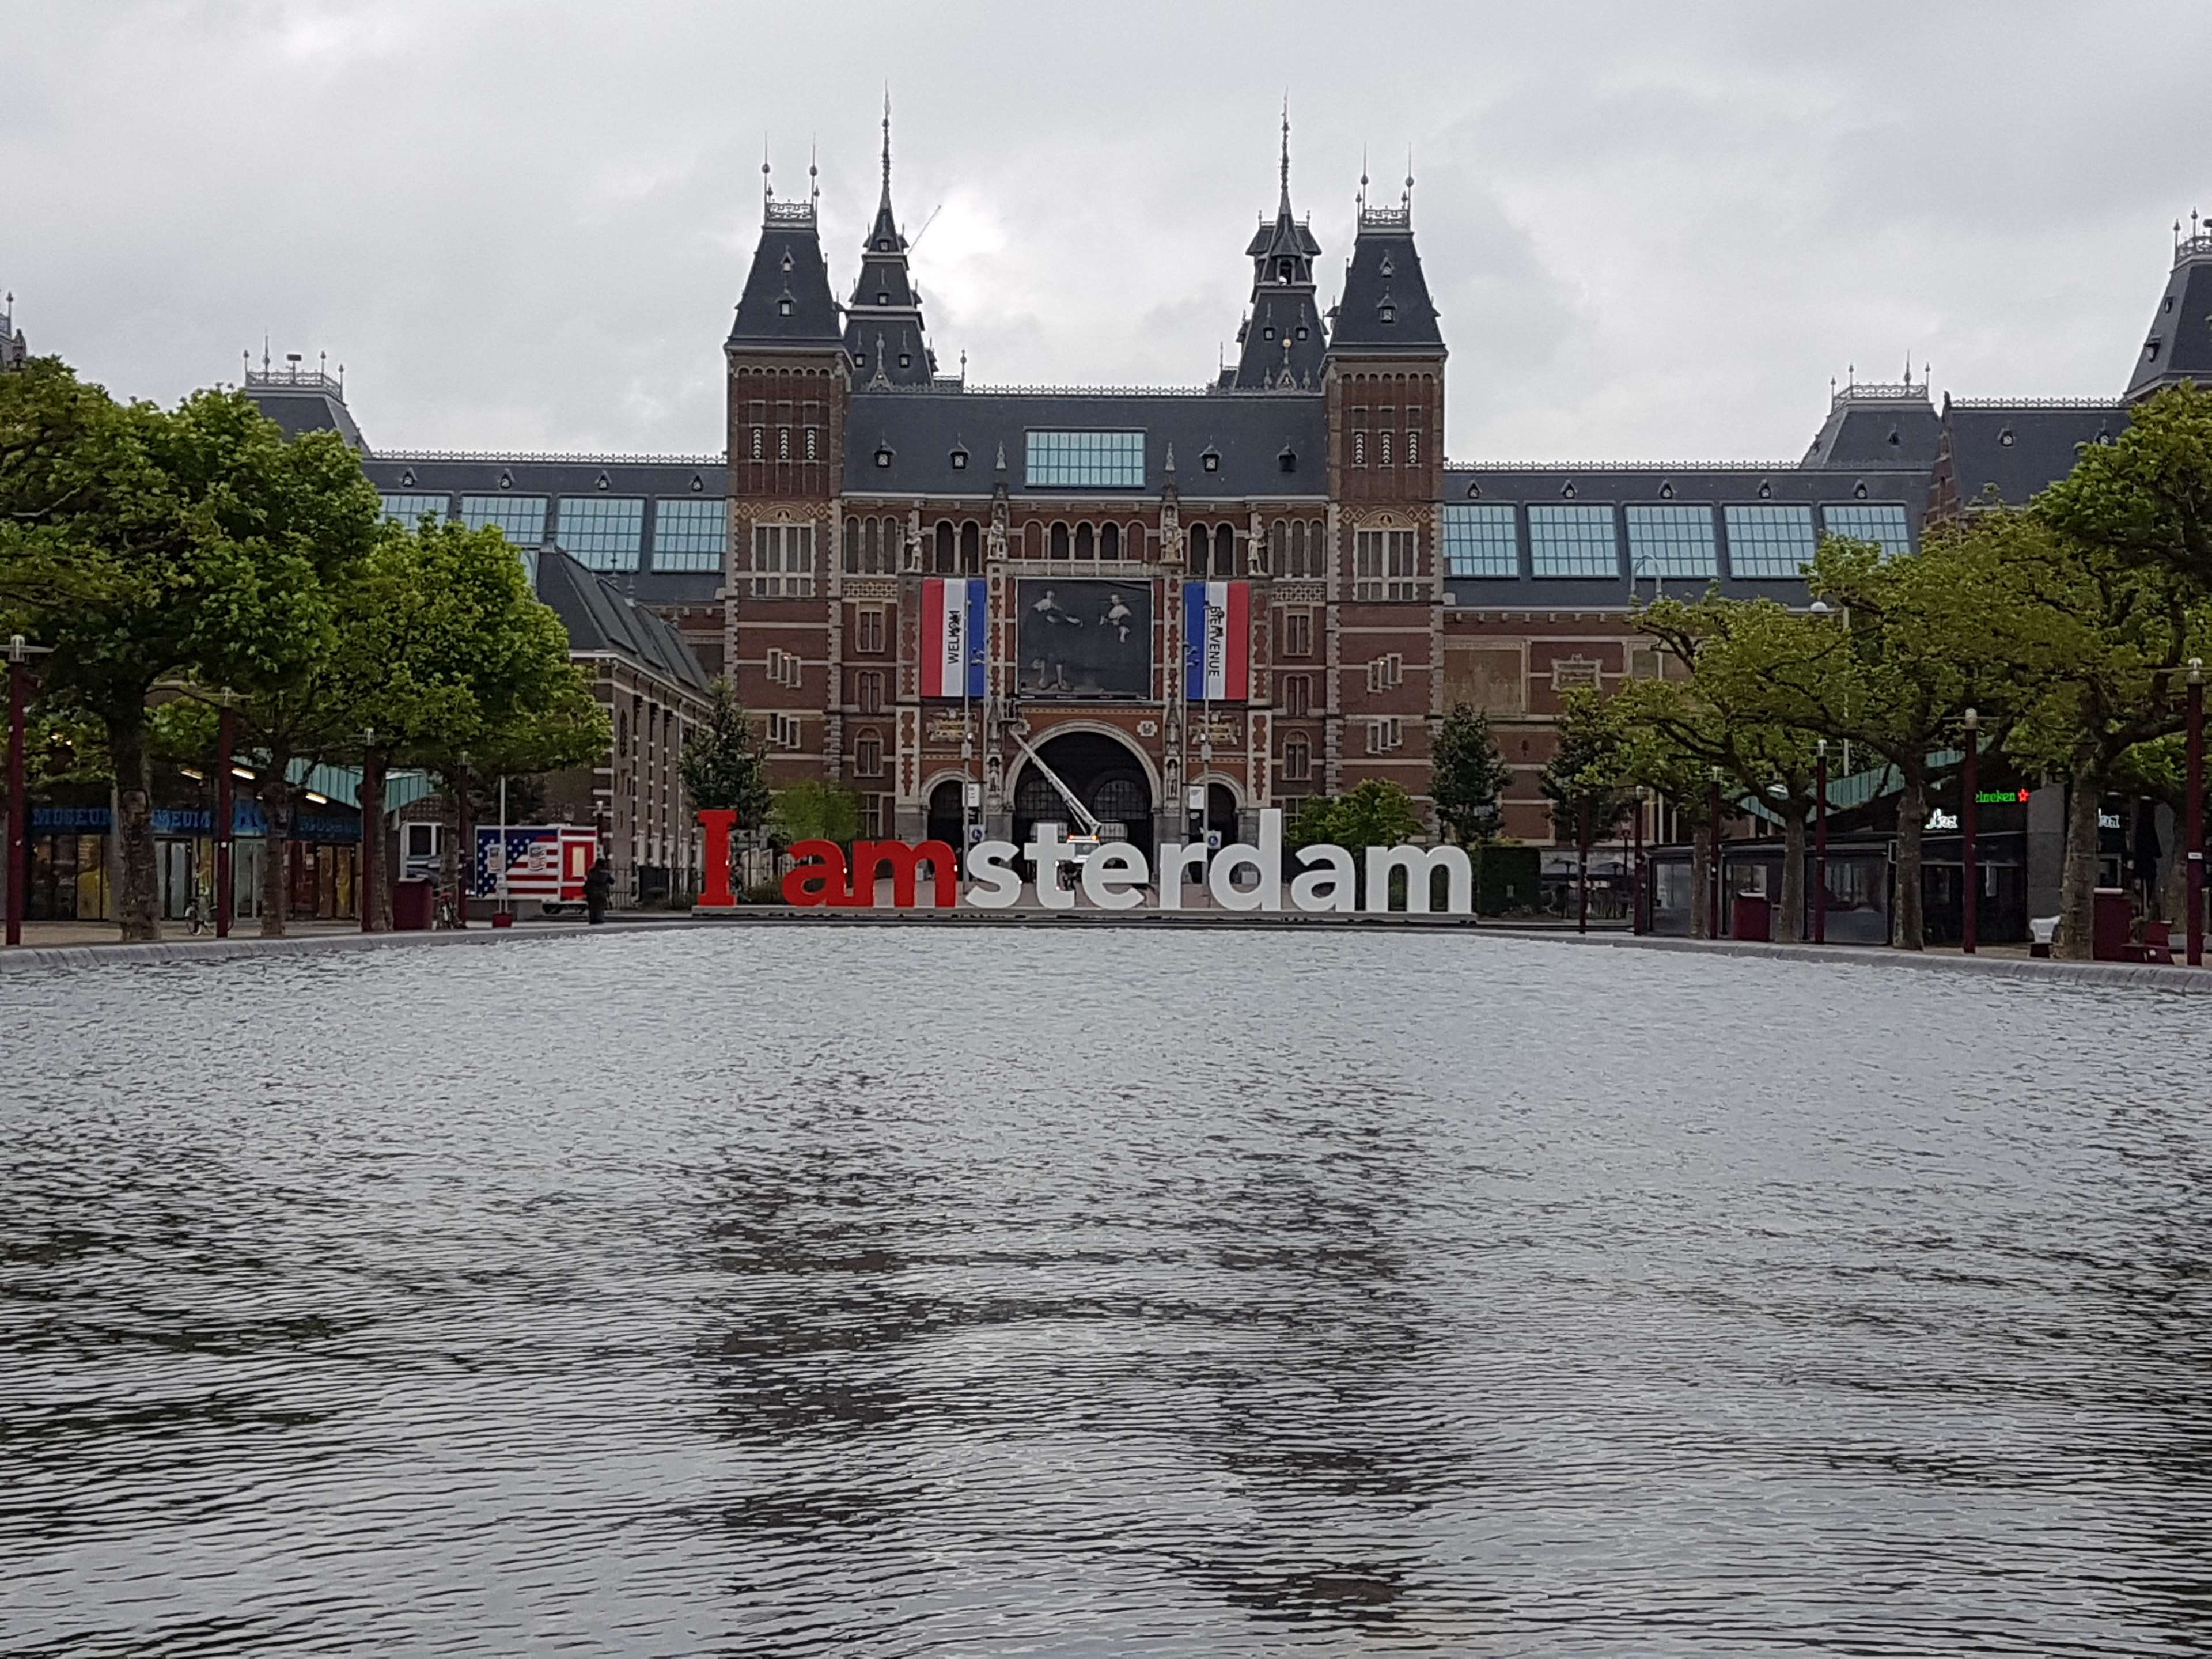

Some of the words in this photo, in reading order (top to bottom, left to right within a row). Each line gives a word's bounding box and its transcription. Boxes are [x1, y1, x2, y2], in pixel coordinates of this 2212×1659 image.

[948, 610, 961, 664] WELKOM
[1209, 606, 1221, 677] BIENVENUE
[1975, 790, 2016, 803] eineken
[698, 809, 737, 906] I
